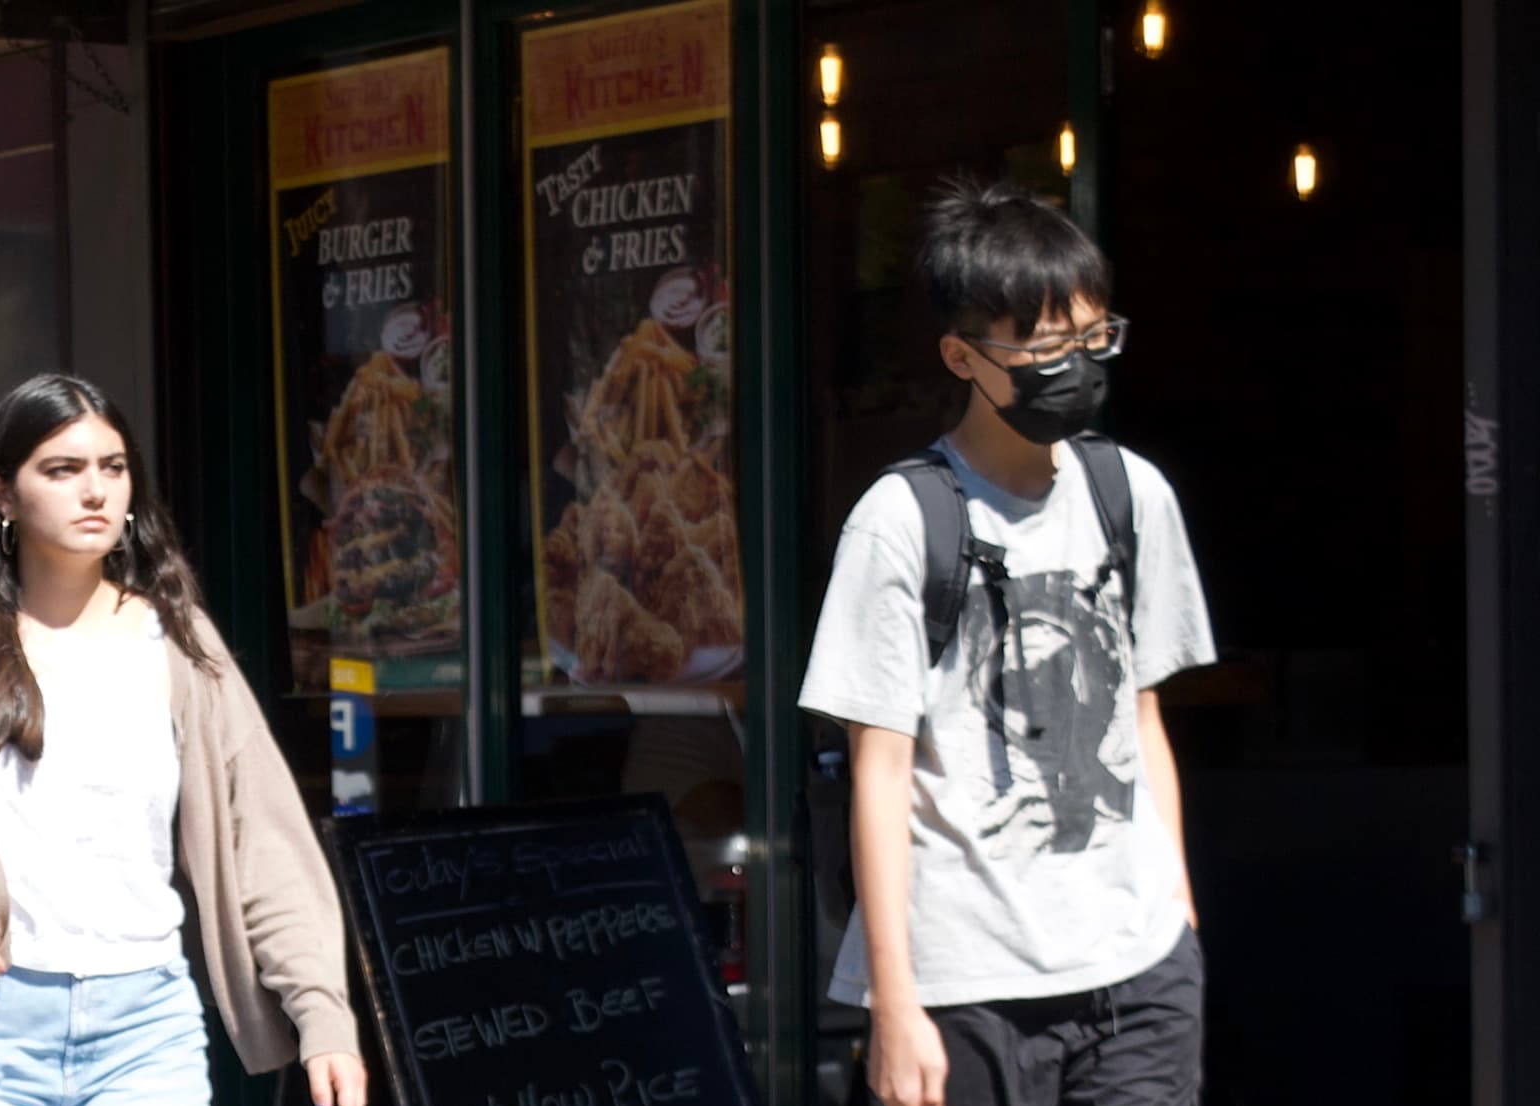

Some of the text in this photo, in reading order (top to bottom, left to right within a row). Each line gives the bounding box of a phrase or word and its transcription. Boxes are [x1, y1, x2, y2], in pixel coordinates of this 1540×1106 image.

[564, 39, 704, 121] KITCHEN
[303, 92, 427, 168] KITCHEN
[536, 143, 605, 217] TASTY
[572, 173, 697, 229] CHICKEN
[284, 187, 338, 258] JUICY
[316, 216, 413, 266] BURGER
[582, 223, 688, 275] & FRIES
[345, 261, 414, 308] FRIES
[413, 1002, 548, 1061] STEWED
